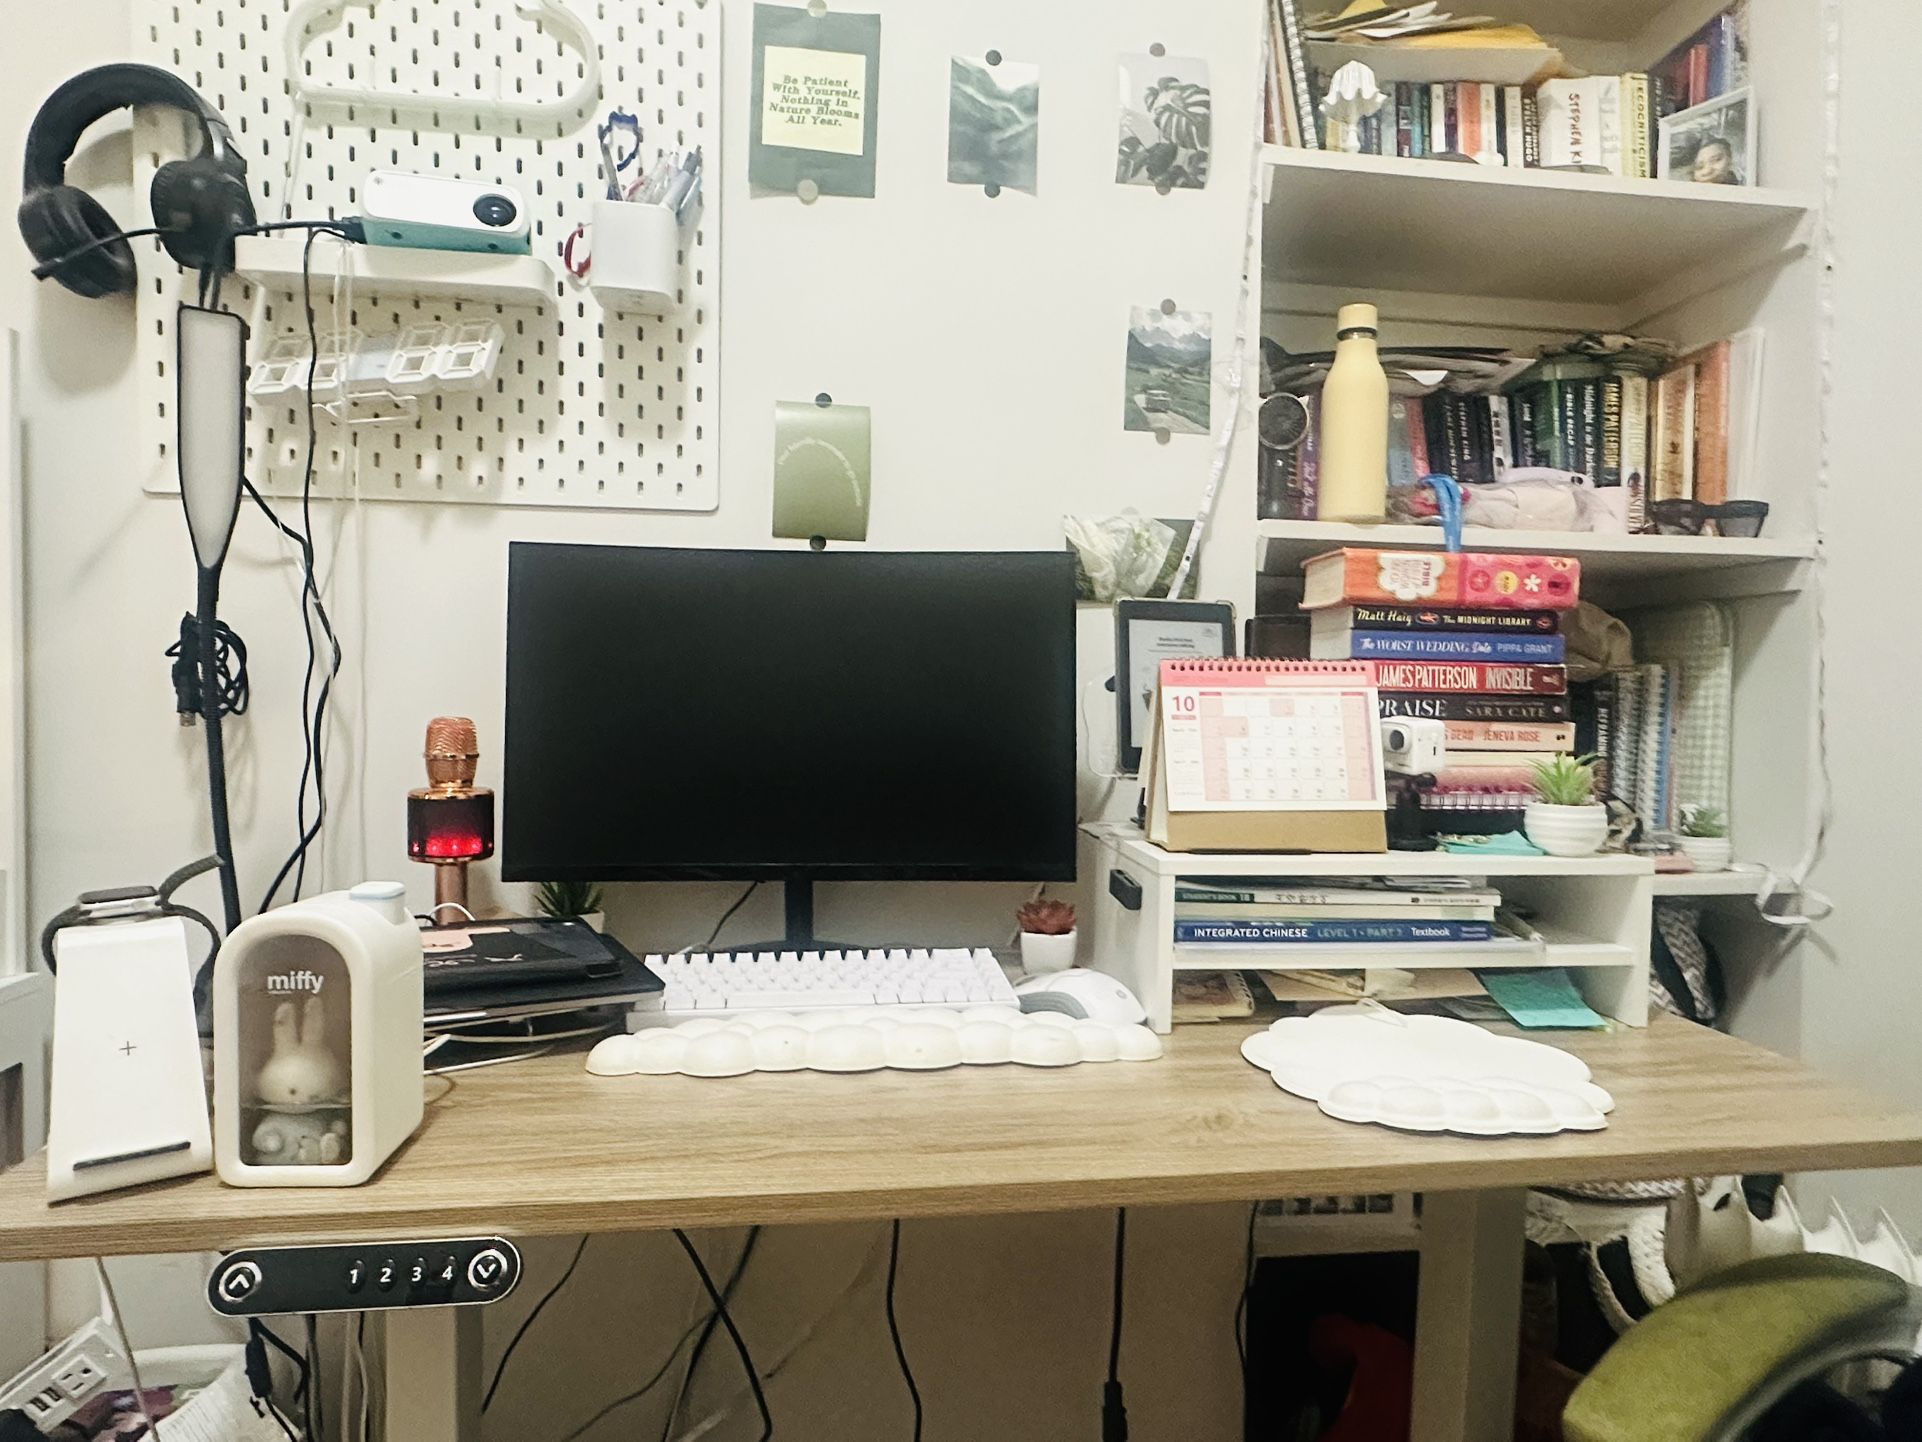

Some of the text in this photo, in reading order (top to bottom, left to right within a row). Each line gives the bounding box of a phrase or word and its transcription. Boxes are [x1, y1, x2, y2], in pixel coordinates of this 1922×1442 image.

[783, 74, 848, 87] Be Patient
[772, 82, 860, 100] With Yourself.
[781, 94, 831, 107] Nothing
[769, 102, 859, 119] Nature Blooms
[1568, 93, 1582, 146] STEPHEN
[785, 114, 842, 127] All Year.
[1525, 135, 1533, 162] HUGO
[1565, 393, 1574, 417] BIBLE
[1583, 384, 1595, 424] Midnight
[1566, 418, 1575, 446] RECAP
[1603, 383, 1620, 468] JAMES PATTERSON
[1462, 440, 1471, 460] KING
[1422, 560, 1431, 587] BIBLE
[1357, 608, 1384, 621] Matt
[1387, 610, 1412, 627] Haig
[1457, 615, 1496, 625] MIDNIGHT
[1498, 617, 1531, 626] LIBRARY
[1360, 638, 1376, 650] The
[1377, 640, 1416, 651] WORST
[1416, 640, 1470, 653] WEDDING
[1497, 642, 1522, 653] PIPPA
[1523, 643, 1553, 655] GRANT
[1376, 664, 1535, 691] JAMES PATTERSON INVISIBLE
[1171, 695, 1195, 712] 10
[1464, 706, 1503, 718] SARA
[1507, 707, 1547, 719] CATE
[1484, 730, 1515, 741] JENEVA
[1517, 730, 1541, 742] ROSE
[1194, 928, 1260, 938] INTEGRATED
[1262, 928, 1308, 938] CHINESE
[1317, 928, 1350, 938] LEVEL
[1366, 928, 1395, 938] PART
[1411, 927, 1451, 937] Textbook
[267, 970, 324, 994] miffy
[350, 1264, 453, 1284] 1 2 3 4
